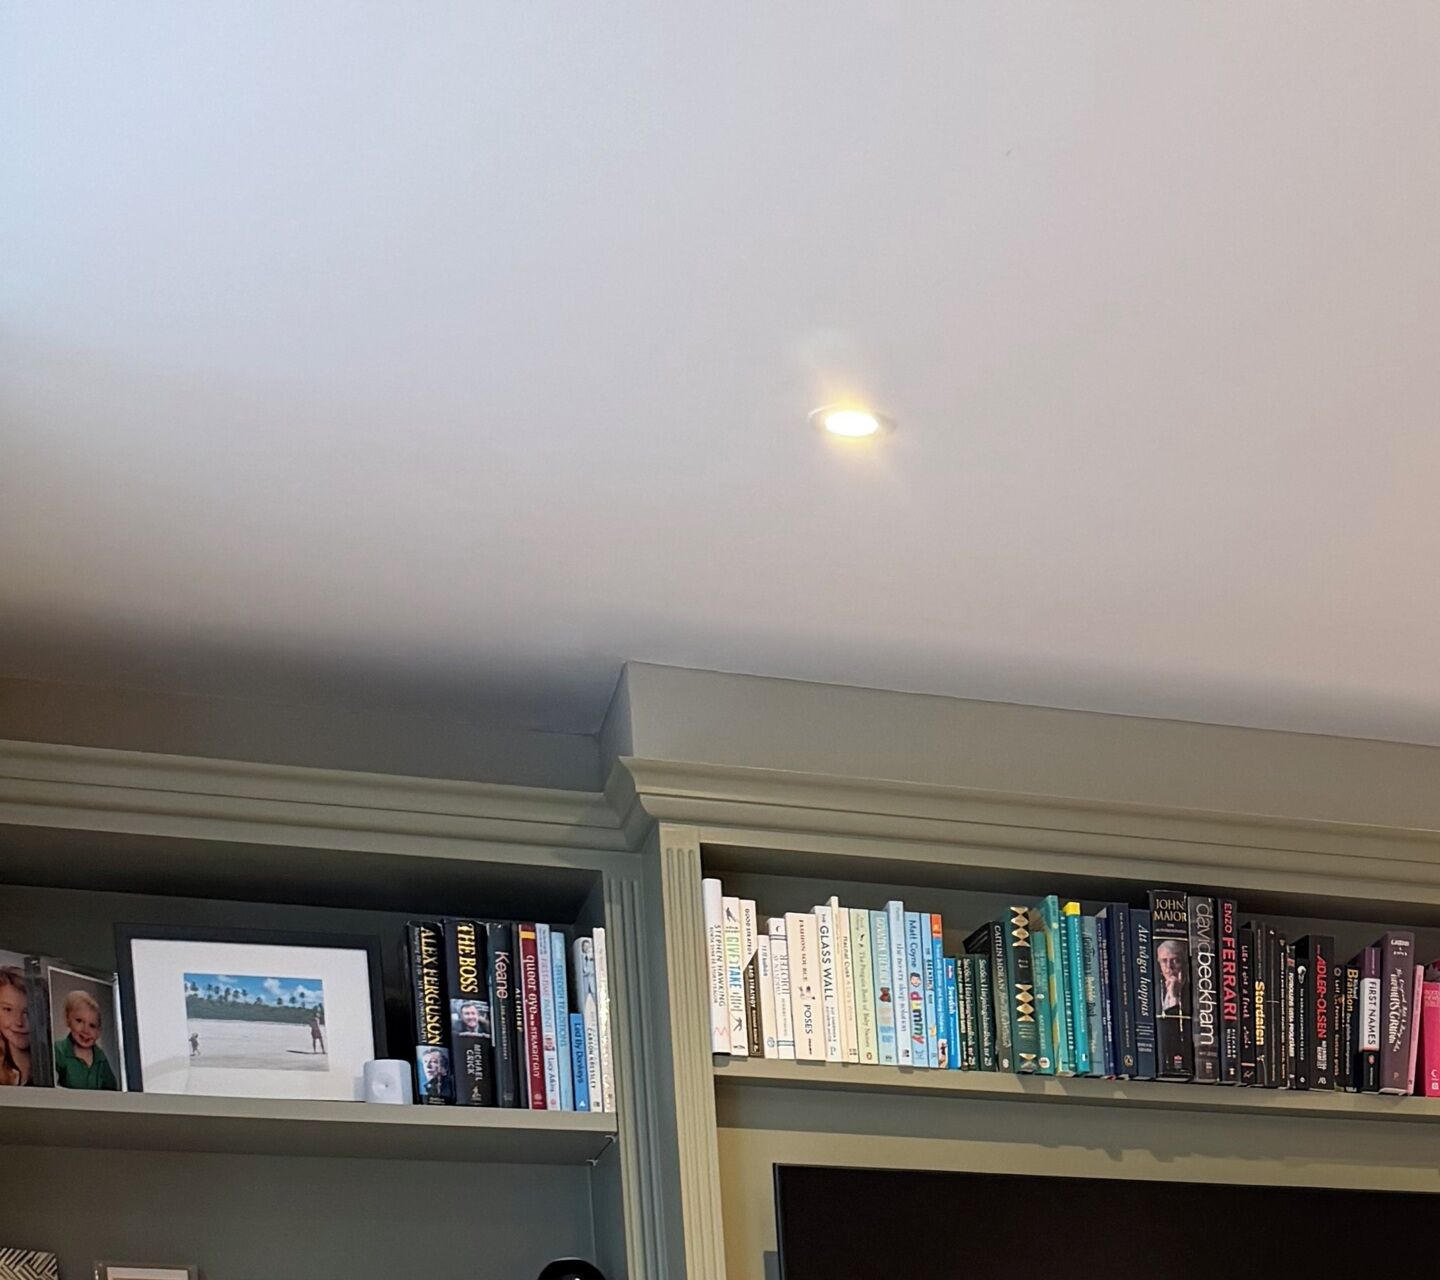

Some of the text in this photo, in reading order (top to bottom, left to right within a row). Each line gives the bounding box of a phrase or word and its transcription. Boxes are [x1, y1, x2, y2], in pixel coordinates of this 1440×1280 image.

[1153, 911, 1188, 921] MAJOR
[1156, 899, 1185, 910] JOHN
[457, 923, 478, 992] THE BOSS
[726, 936, 738, 961] GIVE
[819, 925, 830, 964] GLASS
[909, 942, 918, 967] Coyne
[421, 926, 443, 1045] ALEX FERGUSON
[494, 951, 510, 998] Keane
[523, 954, 538, 1013] queer eye
[716, 965, 725, 1006] HAWKING
[728, 965, 741, 989] TAKE
[822, 967, 833, 1000] WALL
[1136, 924, 1152, 1016] Att våga hoppas
[1221, 936, 1236, 1020] FERRARI
[1346, 968, 1358, 1011] Branson
[555, 964, 567, 1046] SWEDISH TRADITIONS
[1255, 980, 1265, 1045] Stordalen
[1316, 955, 1326, 1037] ADLER-OLSEN
[803, 1004, 812, 1034] POSES
[910, 991, 924, 1044] dummy
[473, 1044, 482, 1080] MICHAEL
[530, 1026, 539, 1060] STRAIGHT
[574, 1038, 583, 1048] By
[575, 1050, 585, 1083] Donkeys
